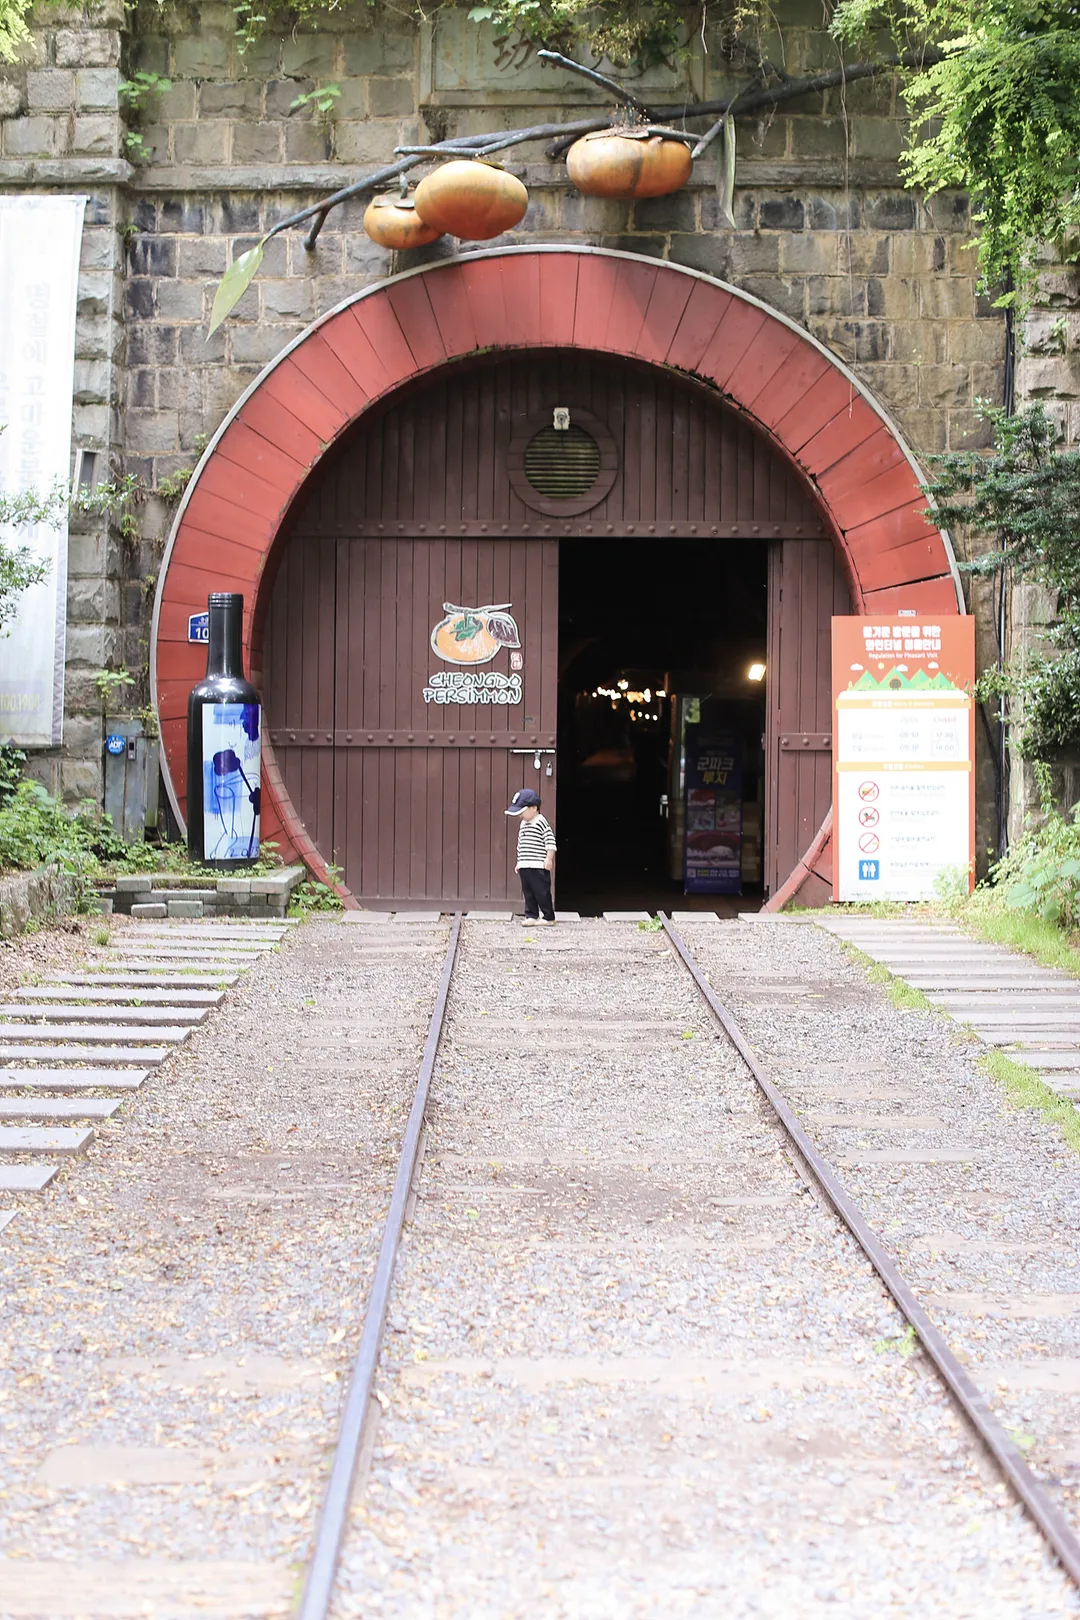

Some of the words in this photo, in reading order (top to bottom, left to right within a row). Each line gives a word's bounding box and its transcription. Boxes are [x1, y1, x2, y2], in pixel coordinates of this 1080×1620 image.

[868, 652, 895, 660] Regulation
[429, 672, 522, 688] CHEONGDO
[423, 687, 521, 704] PERSIMMON
